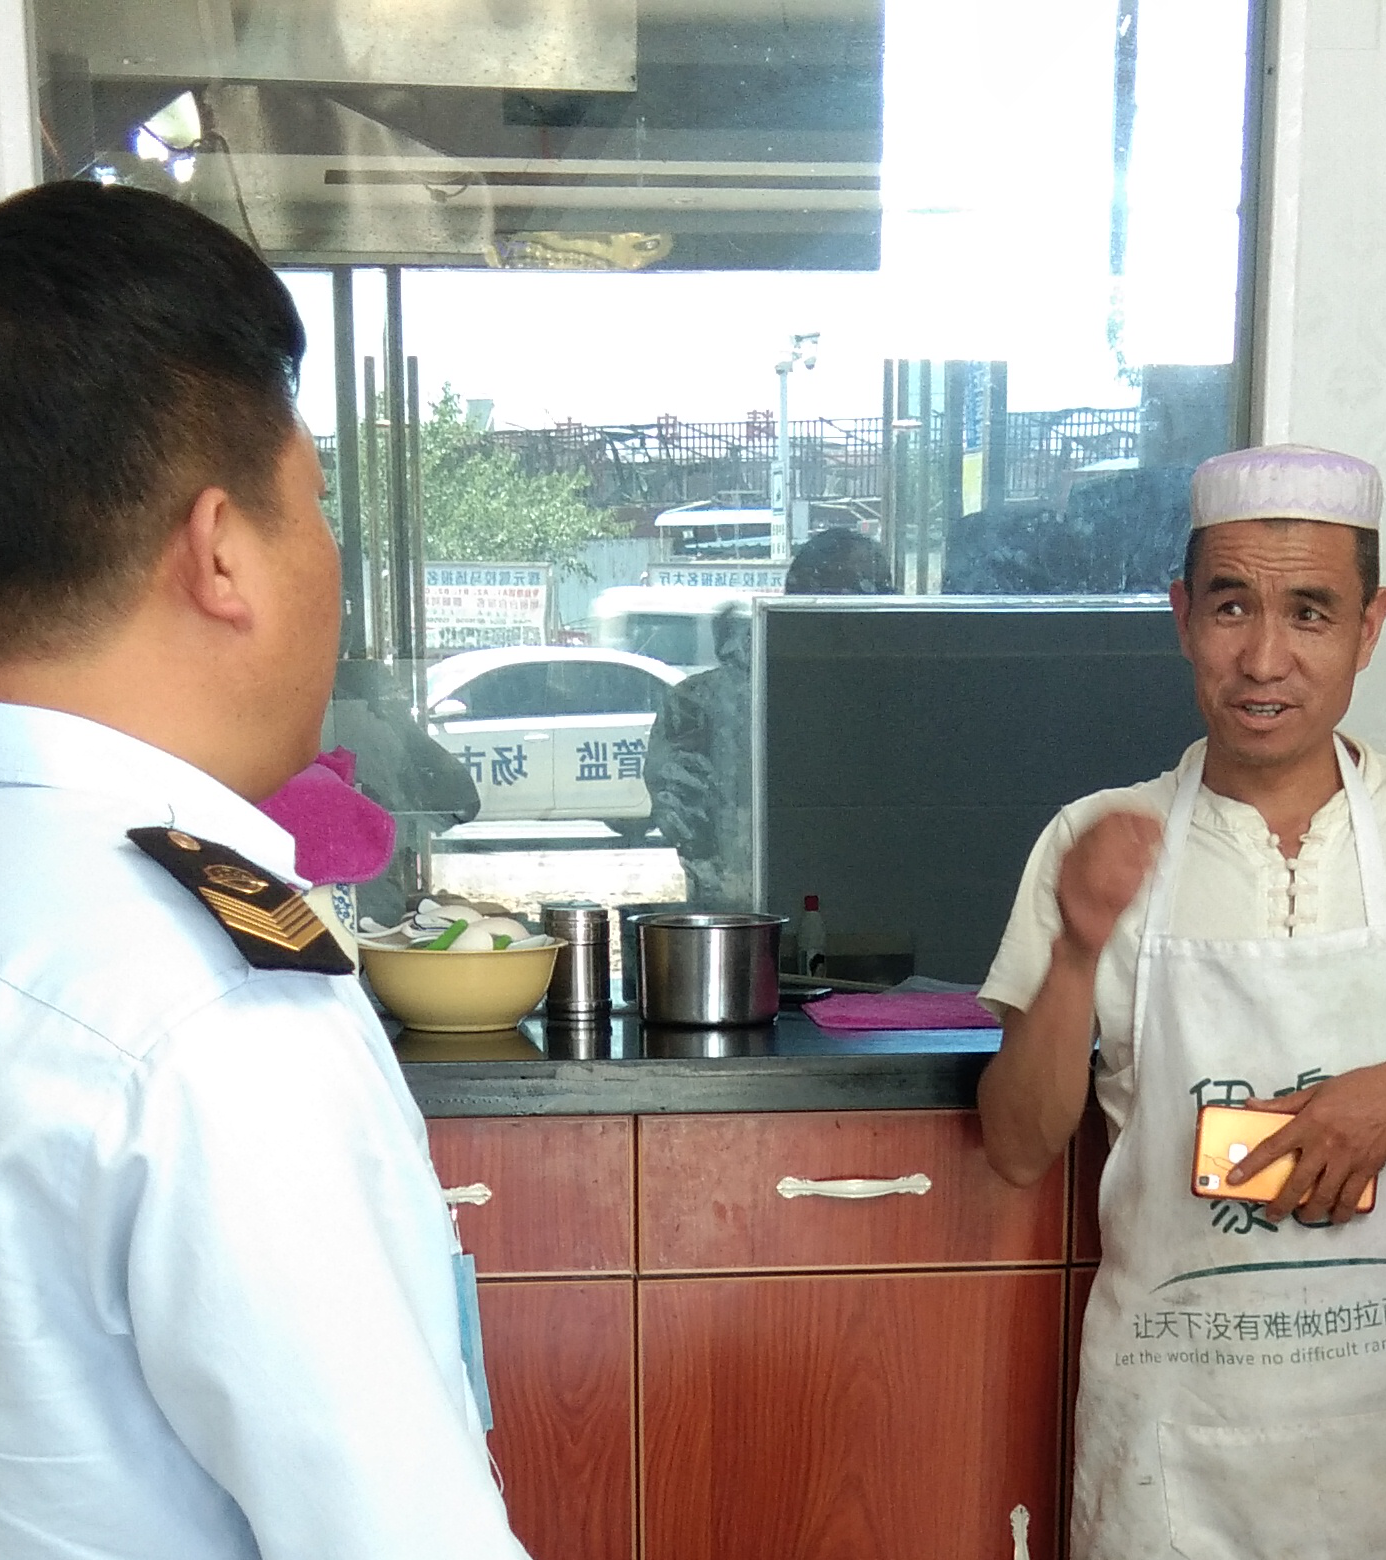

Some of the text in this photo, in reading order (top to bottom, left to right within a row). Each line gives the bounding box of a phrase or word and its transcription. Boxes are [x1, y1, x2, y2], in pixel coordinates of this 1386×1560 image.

[1115, 1353, 1135, 1367] Let
[1139, 1350, 1162, 1364] the
[1167, 1349, 1210, 1364] world
[1215, 1350, 1255, 1366] have
[1261, 1352, 1284, 1365] no
[1290, 1341, 1359, 1364] difficult
